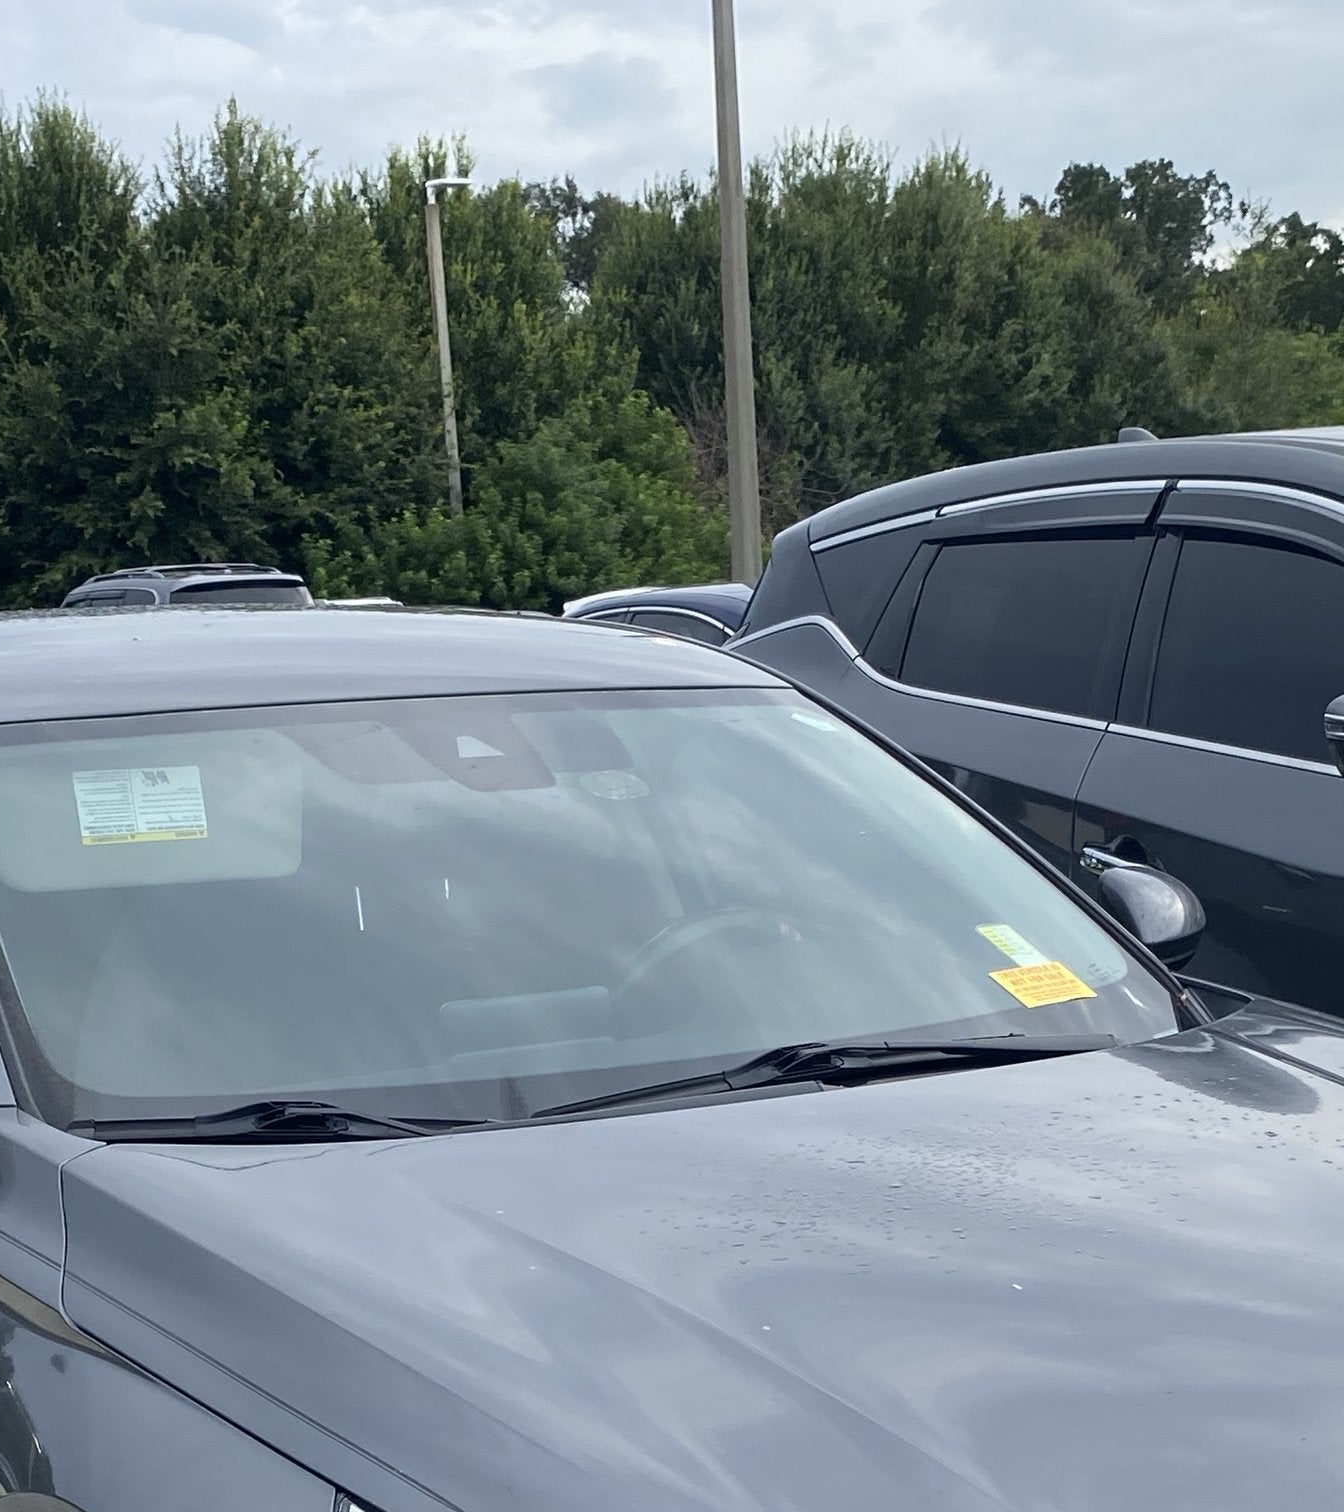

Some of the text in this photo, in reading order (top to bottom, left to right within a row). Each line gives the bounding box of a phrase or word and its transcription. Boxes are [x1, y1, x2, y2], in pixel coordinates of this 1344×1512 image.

[1010, 977, 1027, 986] NOT
[1027, 974, 1045, 983] FOR
[1044, 971, 1065, 980] SALE
